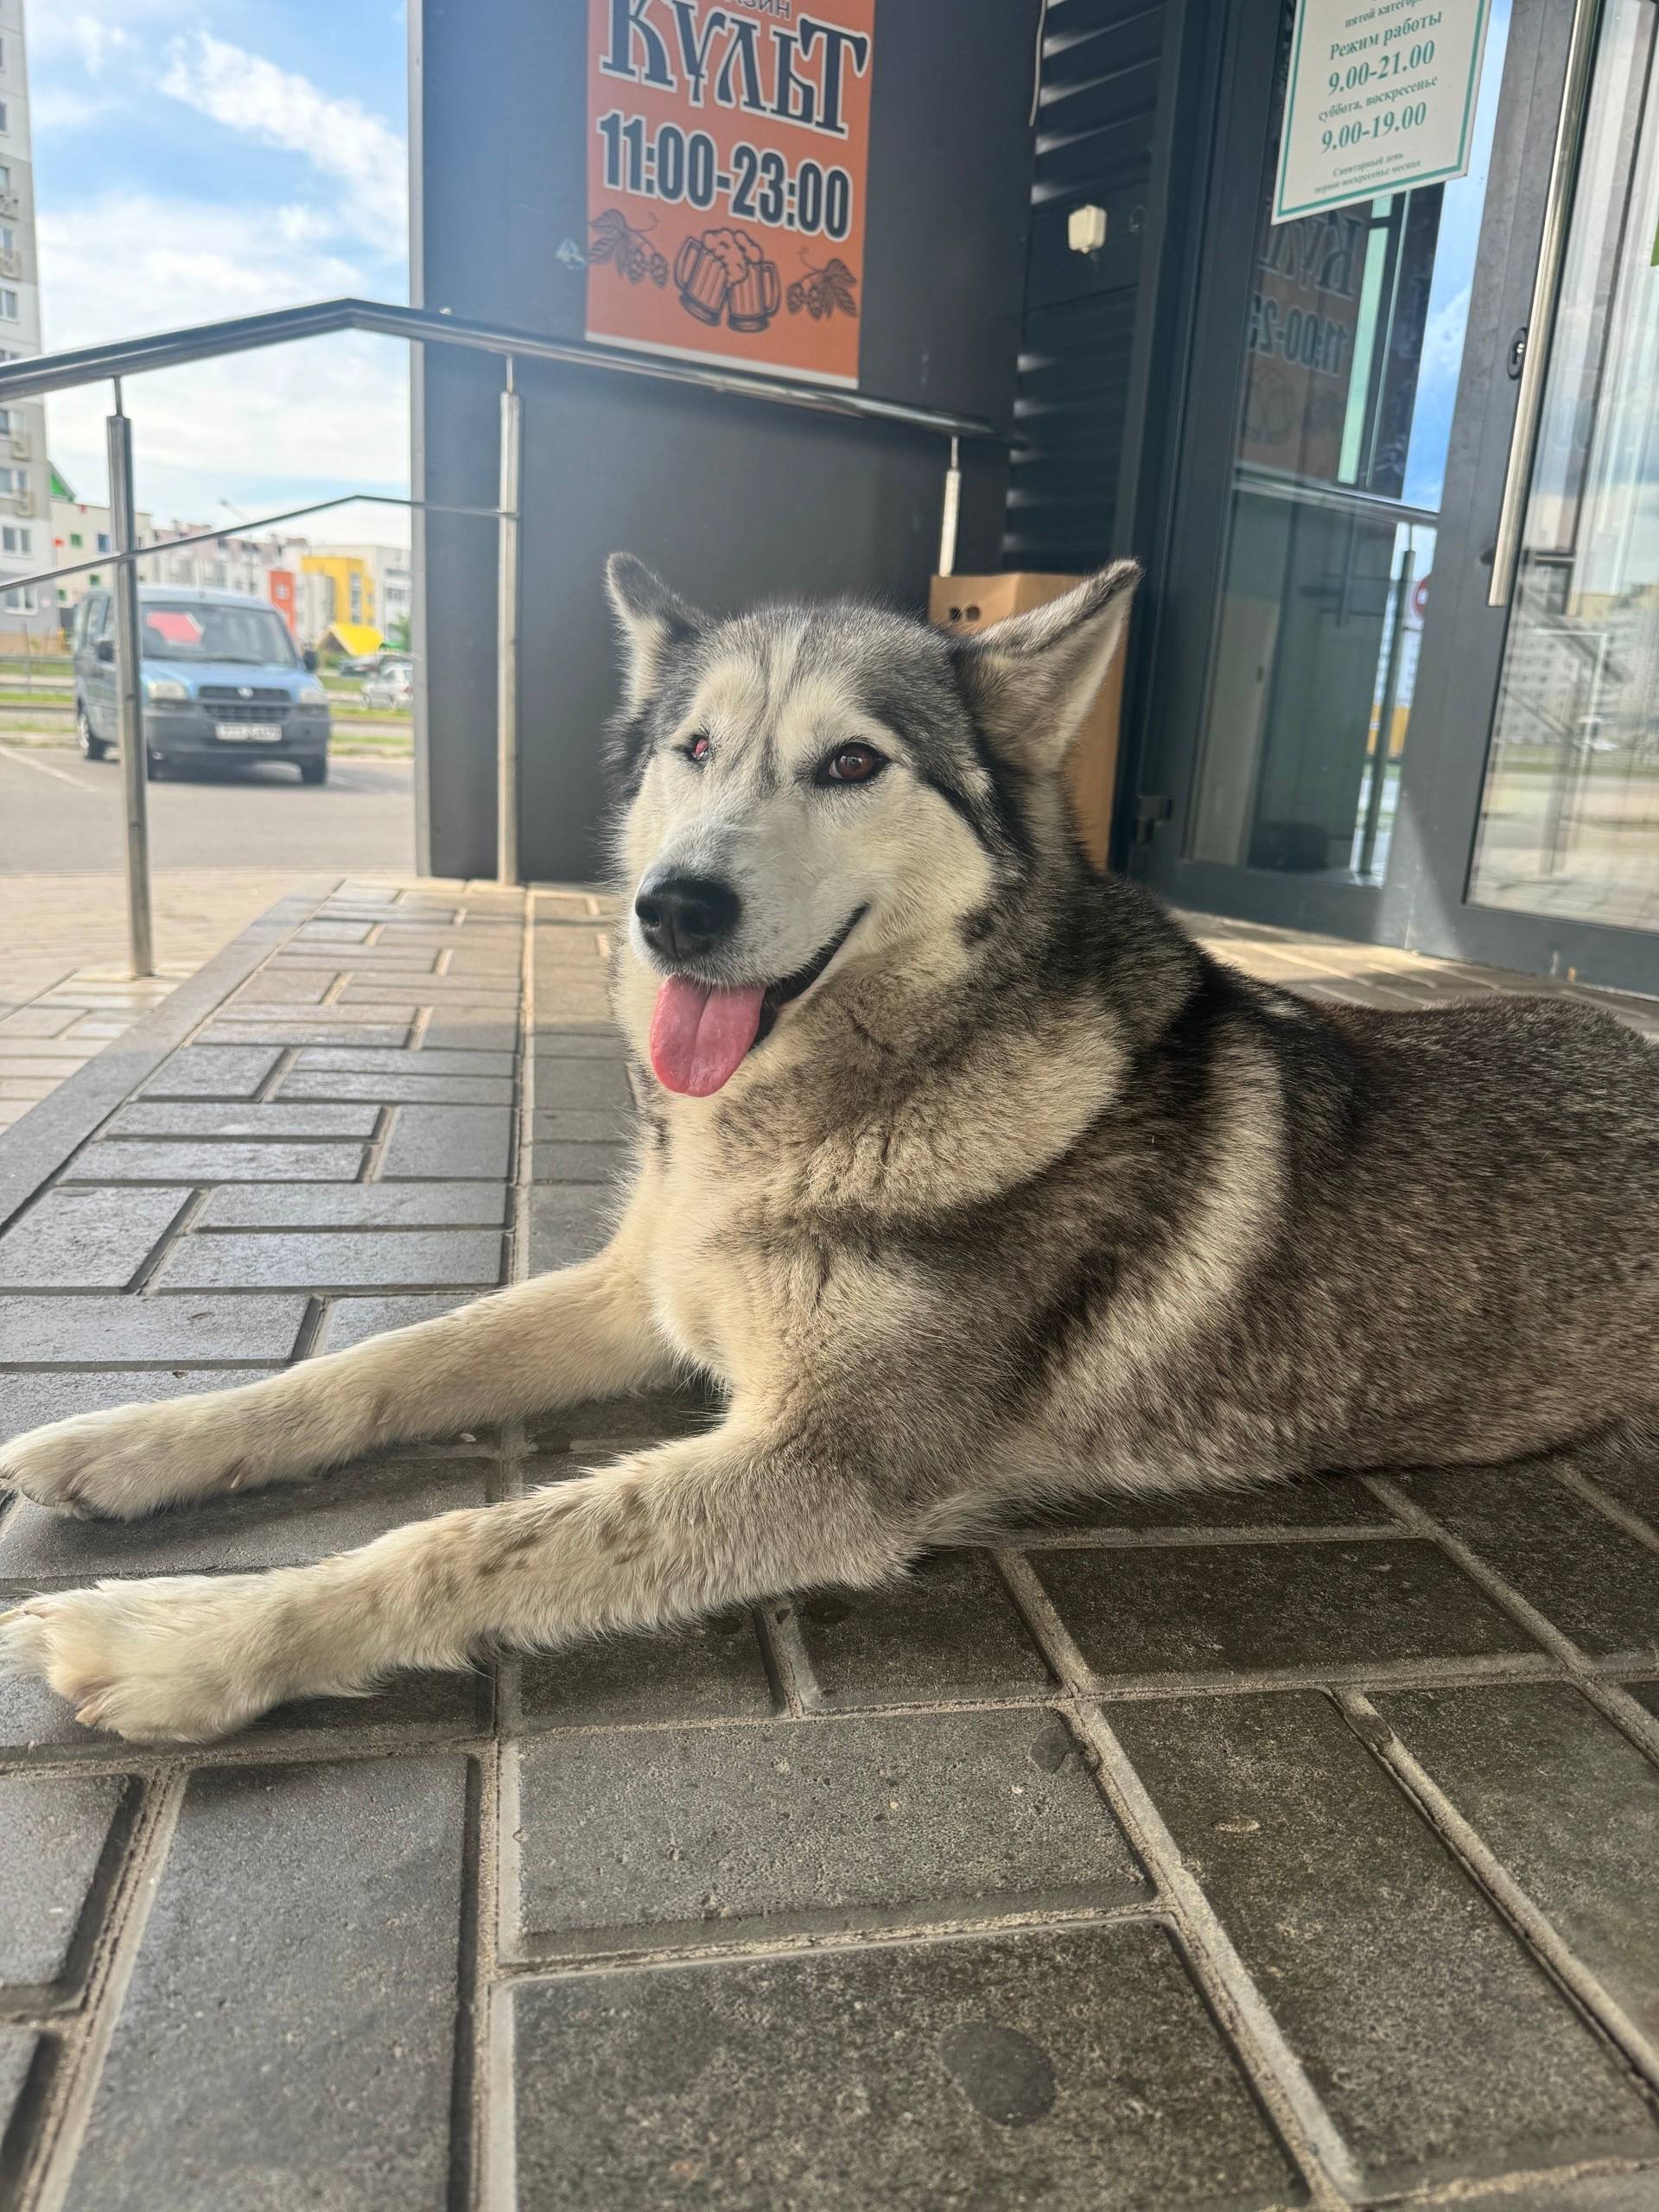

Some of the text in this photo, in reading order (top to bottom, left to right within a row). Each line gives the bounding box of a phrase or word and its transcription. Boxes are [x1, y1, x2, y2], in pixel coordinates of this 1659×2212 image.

[1329, 10, 1442, 60] Режим работы
[1327, 40, 1435, 96] 9.00-21.00
[1318, 75, 1439, 123] суббота, воскресенье
[1320, 101, 1427, 154] 9.00-19.00
[597, 110, 853, 243] 11:00-23:00
